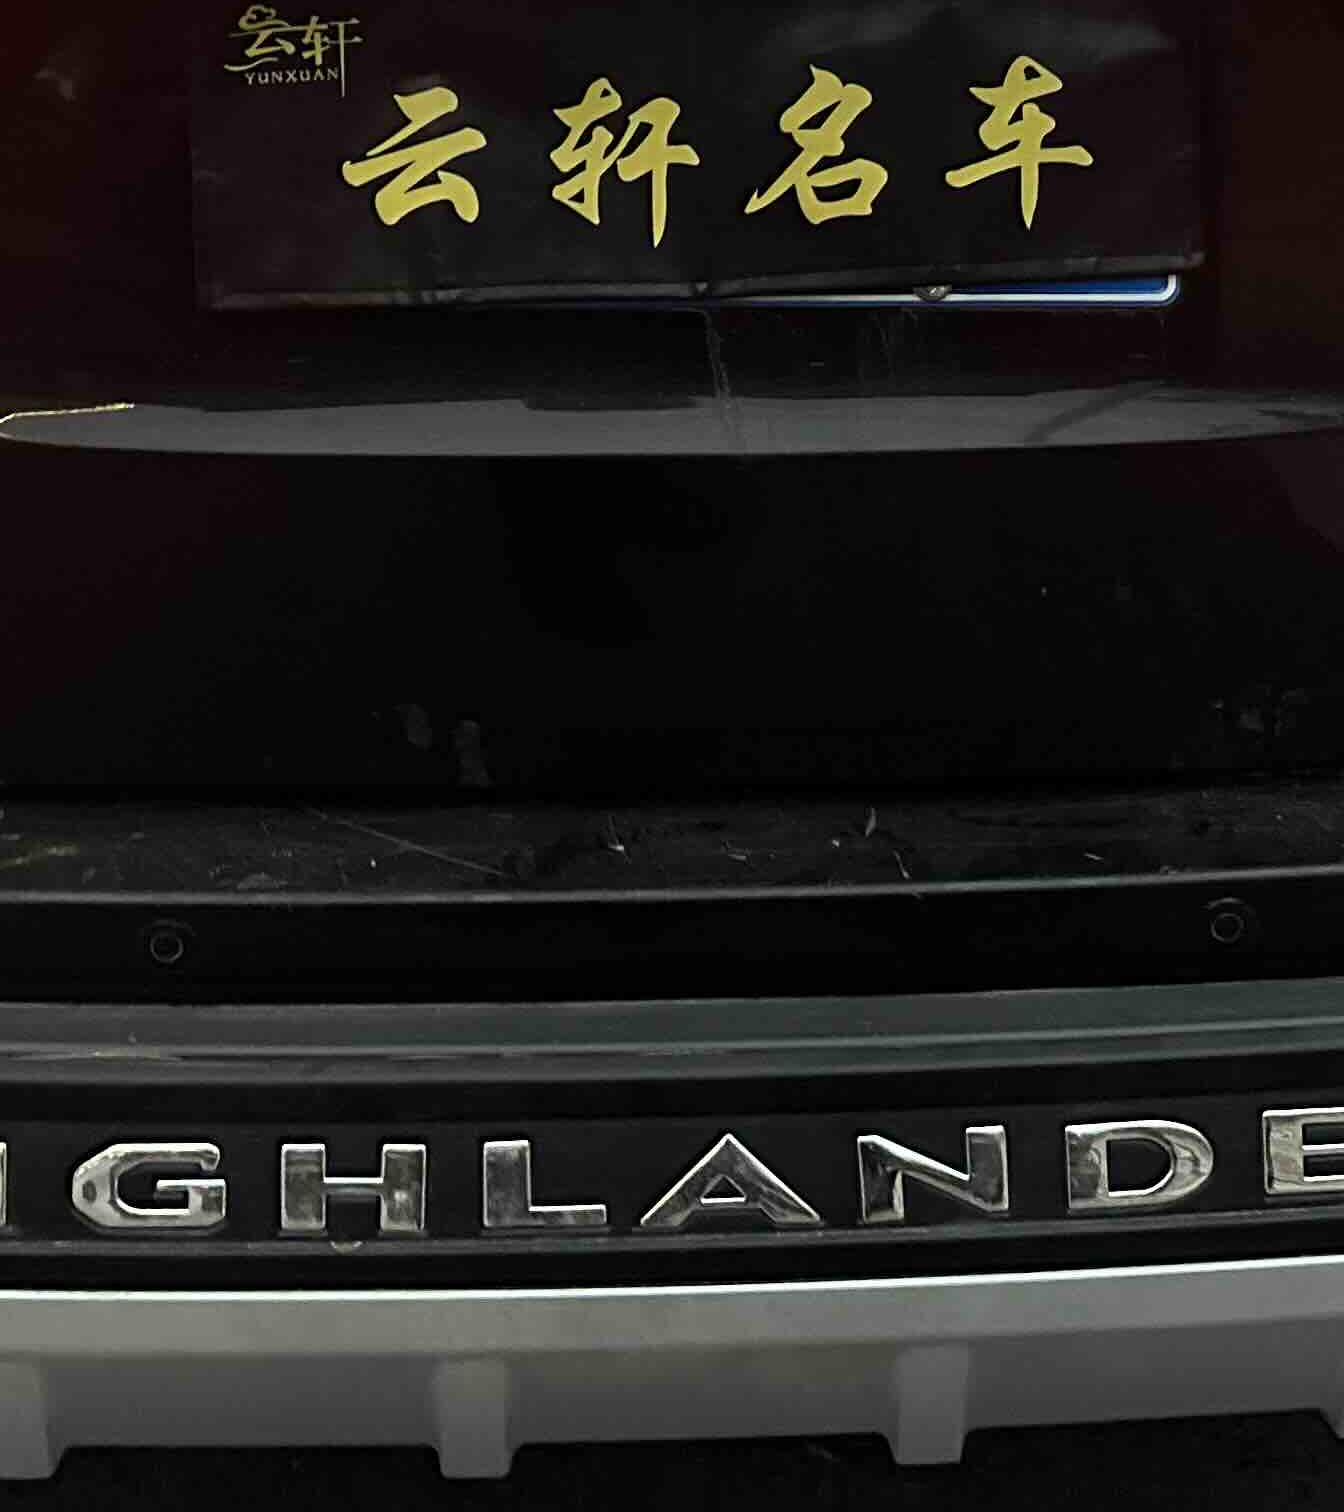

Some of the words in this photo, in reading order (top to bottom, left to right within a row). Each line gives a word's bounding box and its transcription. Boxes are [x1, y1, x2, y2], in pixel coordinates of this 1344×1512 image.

[244, 66, 340, 86] YUNXUAN
[341, 55, 1095, 248] 云轩名车
